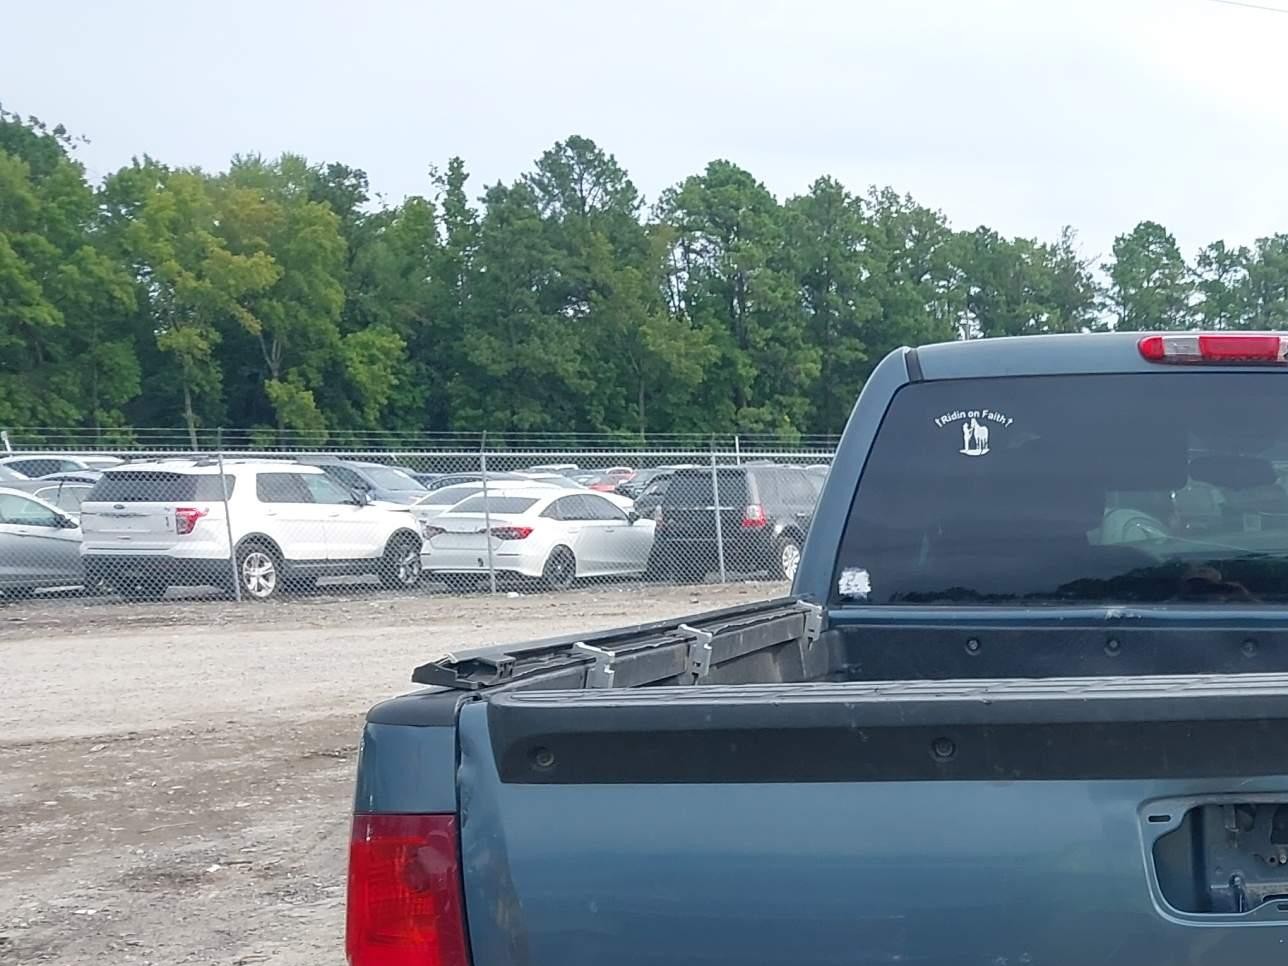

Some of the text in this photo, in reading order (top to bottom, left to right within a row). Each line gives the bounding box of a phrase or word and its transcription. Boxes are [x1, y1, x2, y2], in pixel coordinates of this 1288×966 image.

[940, 409, 1007, 425] Ridin on Faith
